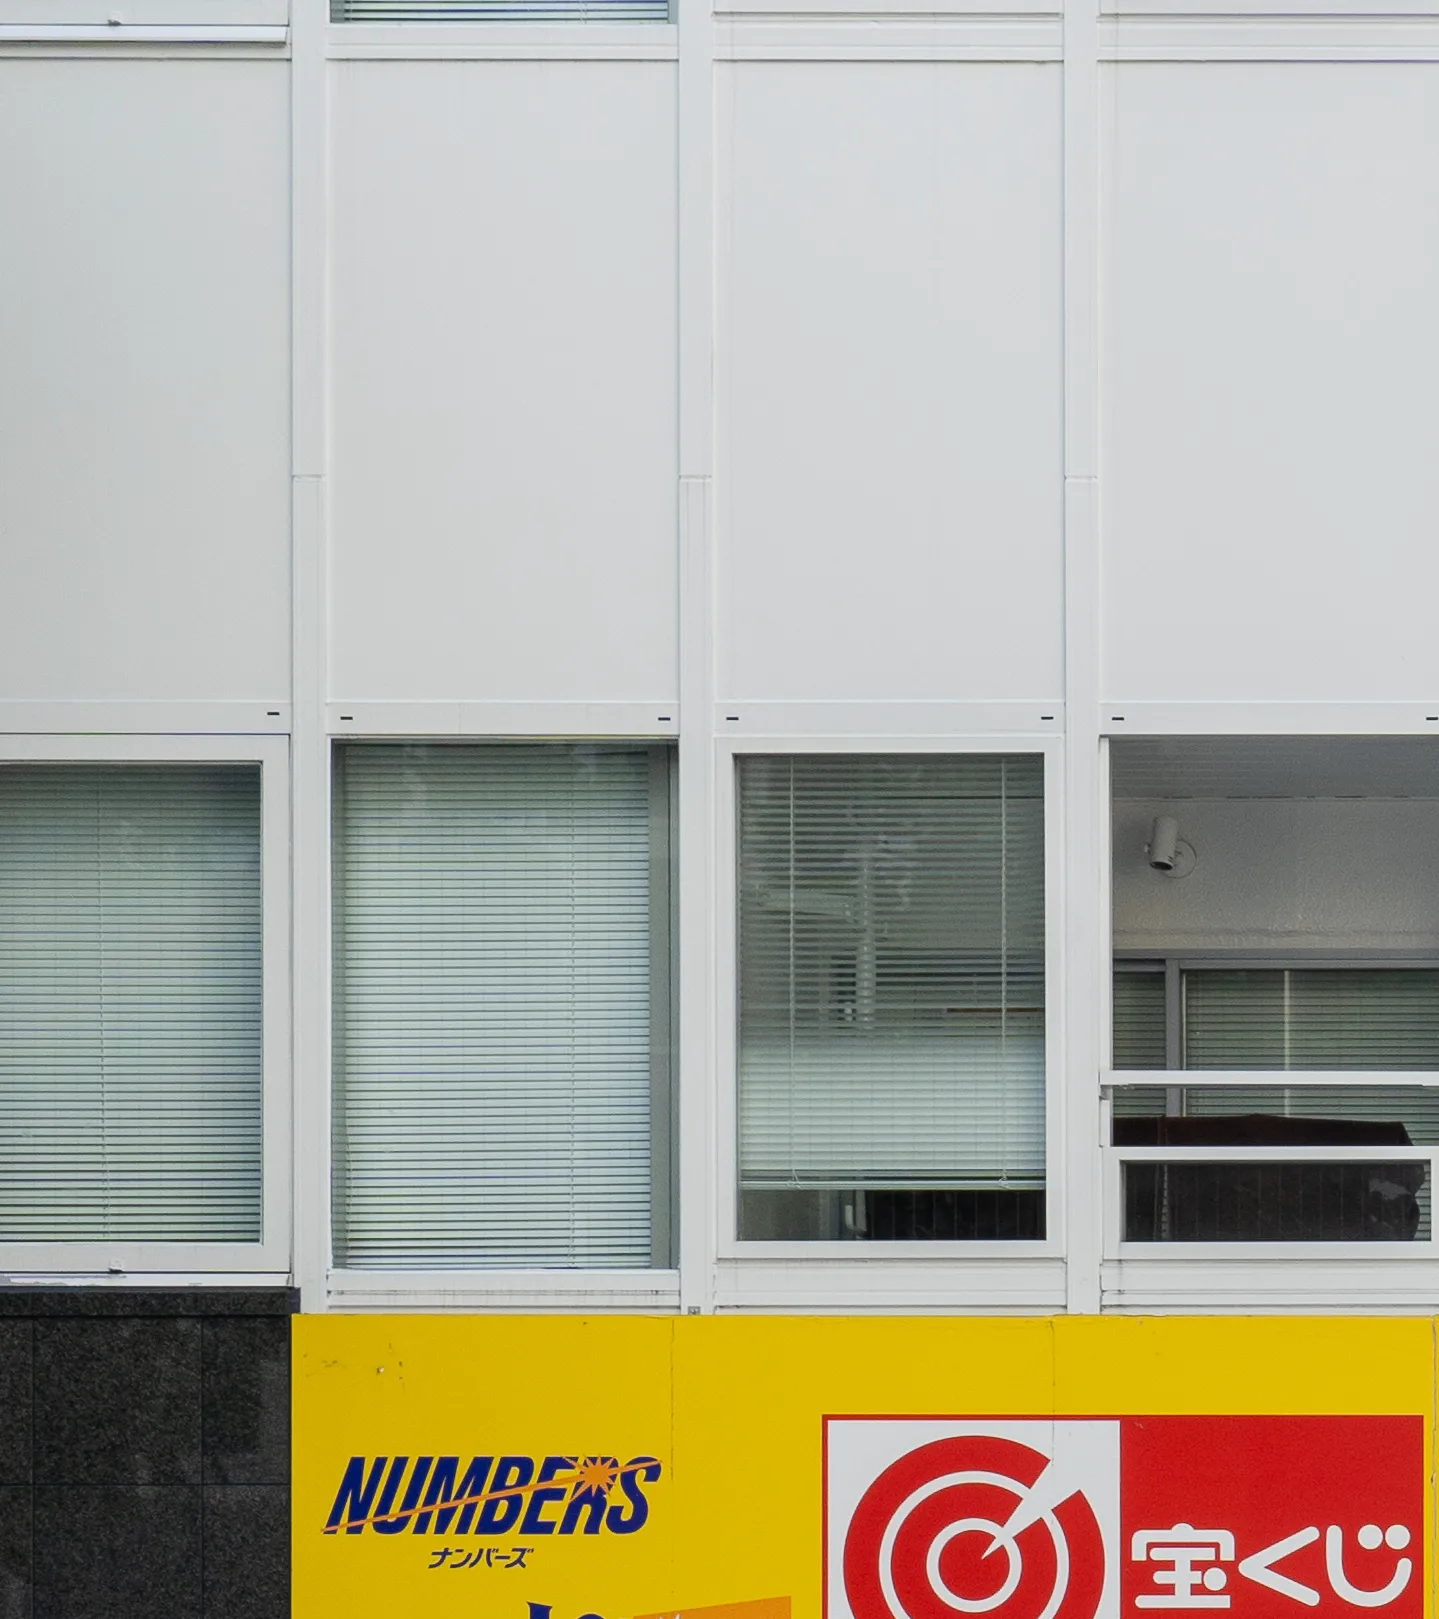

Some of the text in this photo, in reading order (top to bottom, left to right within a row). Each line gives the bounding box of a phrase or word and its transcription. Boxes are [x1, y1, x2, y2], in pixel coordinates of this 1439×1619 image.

[322, 1455, 662, 1535] NUMBERS
[428, 1546, 535, 1569] ナンバーズ
[1132, 1523, 1412, 1609] 宝くじ
